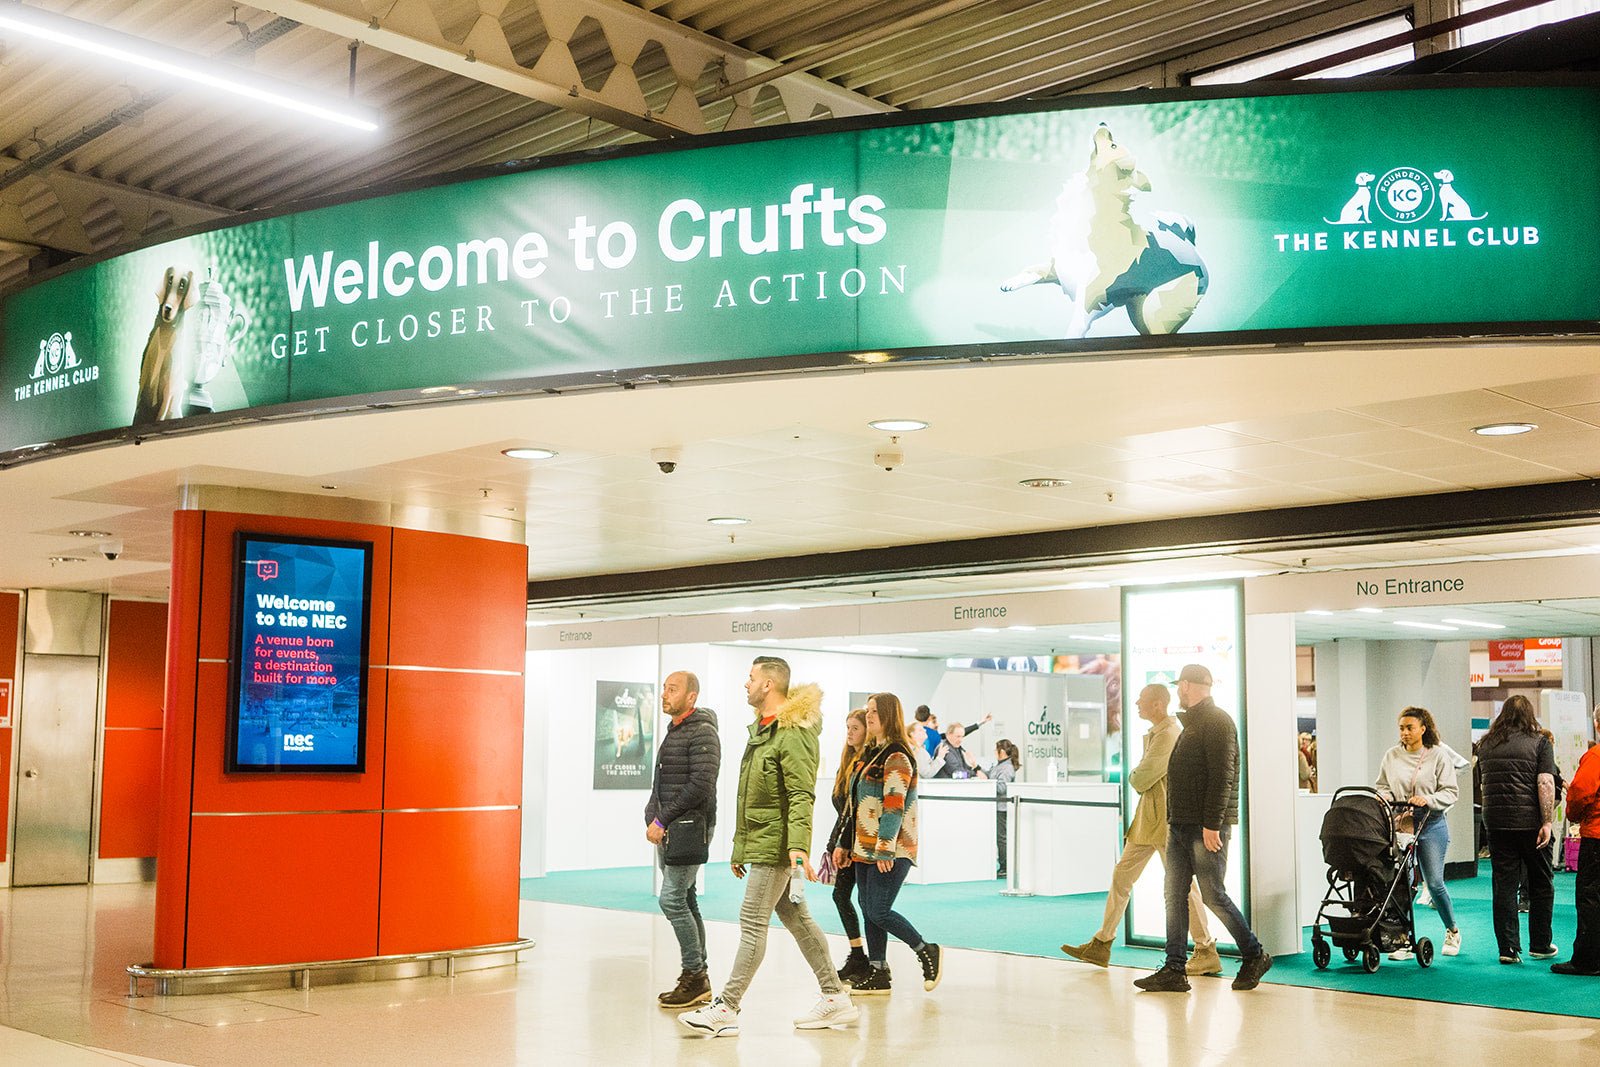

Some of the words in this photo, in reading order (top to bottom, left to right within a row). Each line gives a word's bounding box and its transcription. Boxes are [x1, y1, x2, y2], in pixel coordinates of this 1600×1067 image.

[1381, 171, 1420, 192] FOUNDED
[1421, 181, 1429, 191] IN
[1393, 189, 1417, 201] KC
[1395, 211, 1416, 219] 1873
[1274, 232, 1328, 252] THE
[1343, 229, 1456, 250] KENNEL
[1467, 226, 1540, 246] CLUB
[284, 230, 548, 312] Welcome
[568, 215, 637, 270] to
[658, 183, 887, 262] Crufts
[271, 326, 330, 360] GET
[351, 305, 495, 347] CLOSER
[521, 296, 571, 327] TO
[600, 284, 684, 318] THE
[713, 264, 907, 308] ACTION
[15, 385, 31, 401] THE
[34, 374, 70, 396] KENNEL
[73, 365, 99, 385] CLUB
[1357, 581, 1379, 595] No
[1385, 578, 1464, 595] Entrance
[256, 594, 335, 612] Welcome
[256, 611, 275, 626] to
[278, 612, 308, 627] the
[312, 614, 347, 629] NEC
[954, 606, 1007, 620] Entrance
[731, 620, 773, 633] Entrance
[255, 634, 264, 645] A
[267, 636, 303, 646] venue
[306, 635, 334, 647] born
[559, 630, 592, 642] Entrance
[255, 646, 273, 658] for
[276, 649, 319, 661] events,
[254, 661, 262, 670] a
[265, 659, 333, 672] destination
[254, 671, 282, 683] built
[285, 672, 304, 684] for
[306, 675, 337, 685] more
[1028, 721, 1061, 735] Crufts
[284, 734, 314, 746] nec
[1027, 744, 1063, 758] Results
